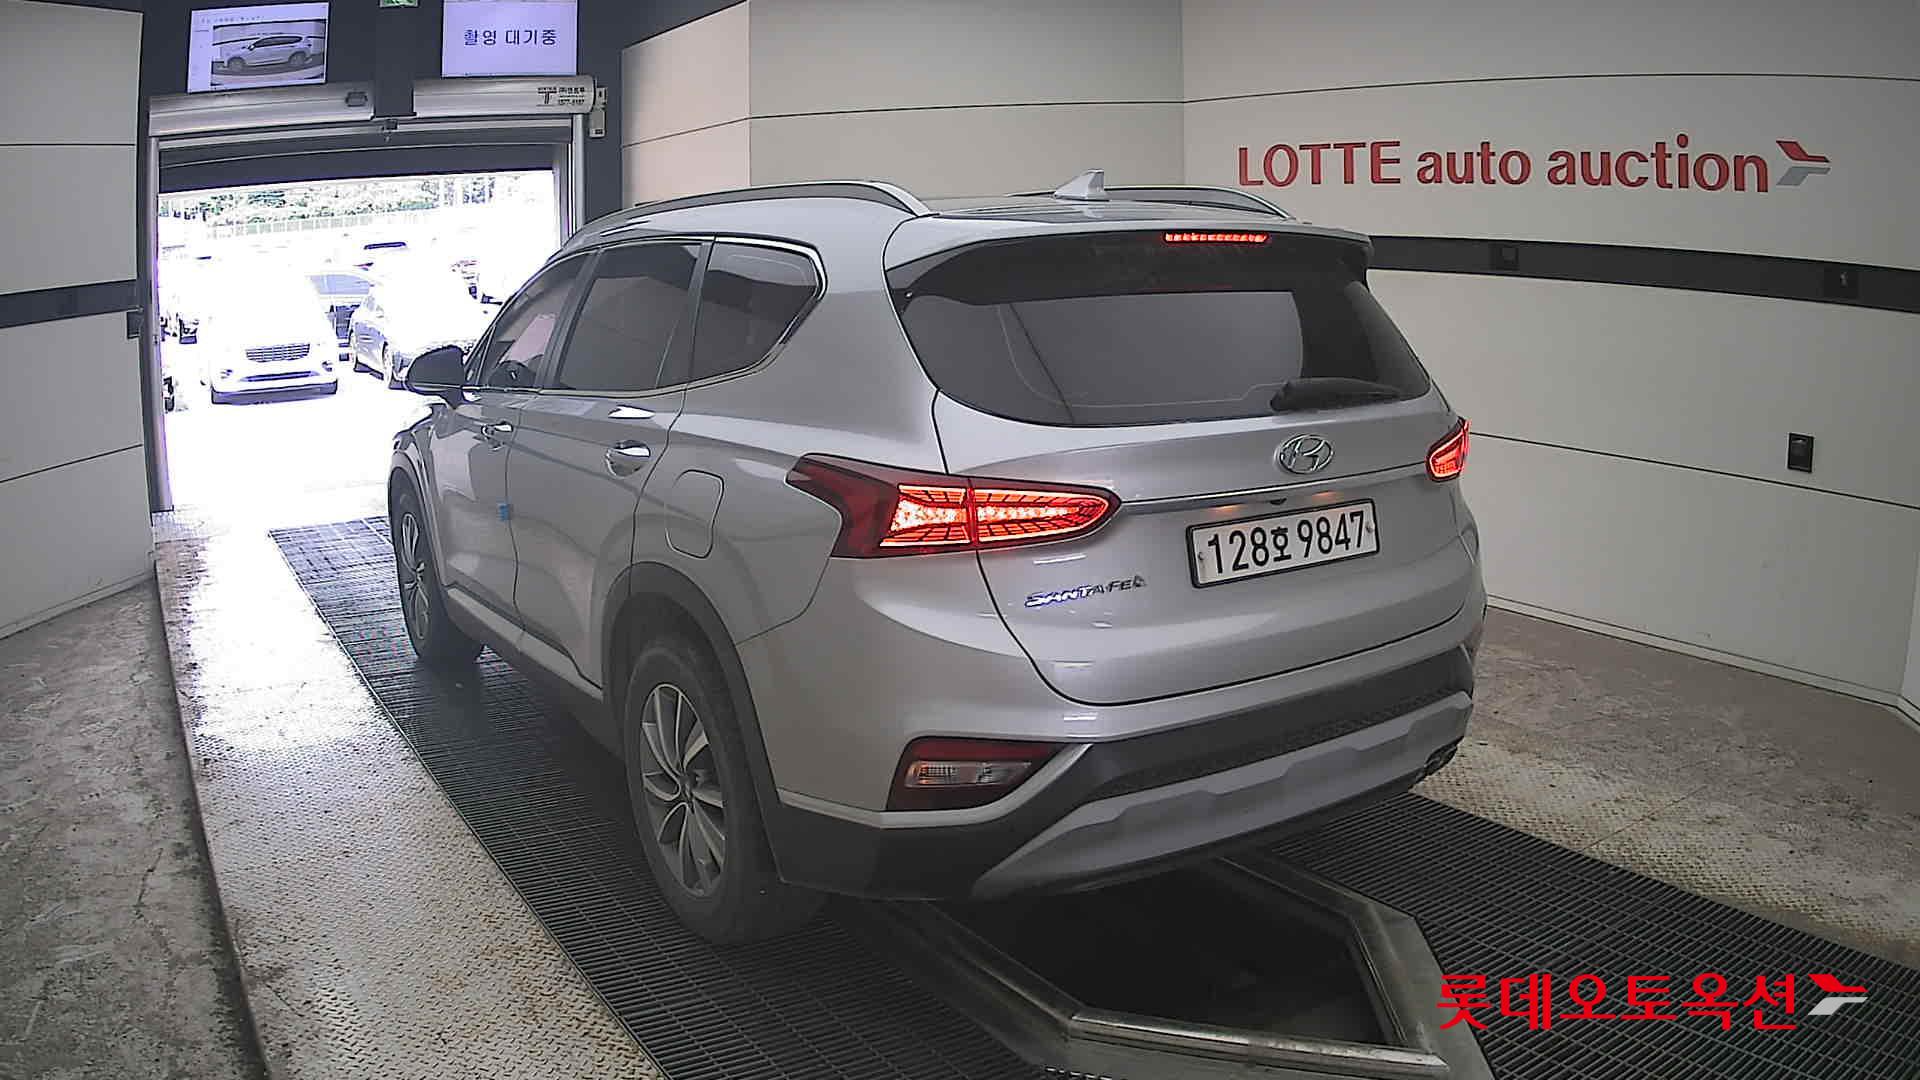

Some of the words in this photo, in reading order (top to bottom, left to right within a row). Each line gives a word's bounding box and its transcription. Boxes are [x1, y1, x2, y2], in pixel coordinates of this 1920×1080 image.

[464, 29, 497, 46] 촬영
[505, 29, 557, 46] 대기중
[1238, 140, 1402, 187] LOTTE
[1416, 140, 1532, 186] auto
[1546, 133, 1769, 193] auction
[1207, 526, 1292, 575] 128호
[1296, 510, 1364, 558] 9847
